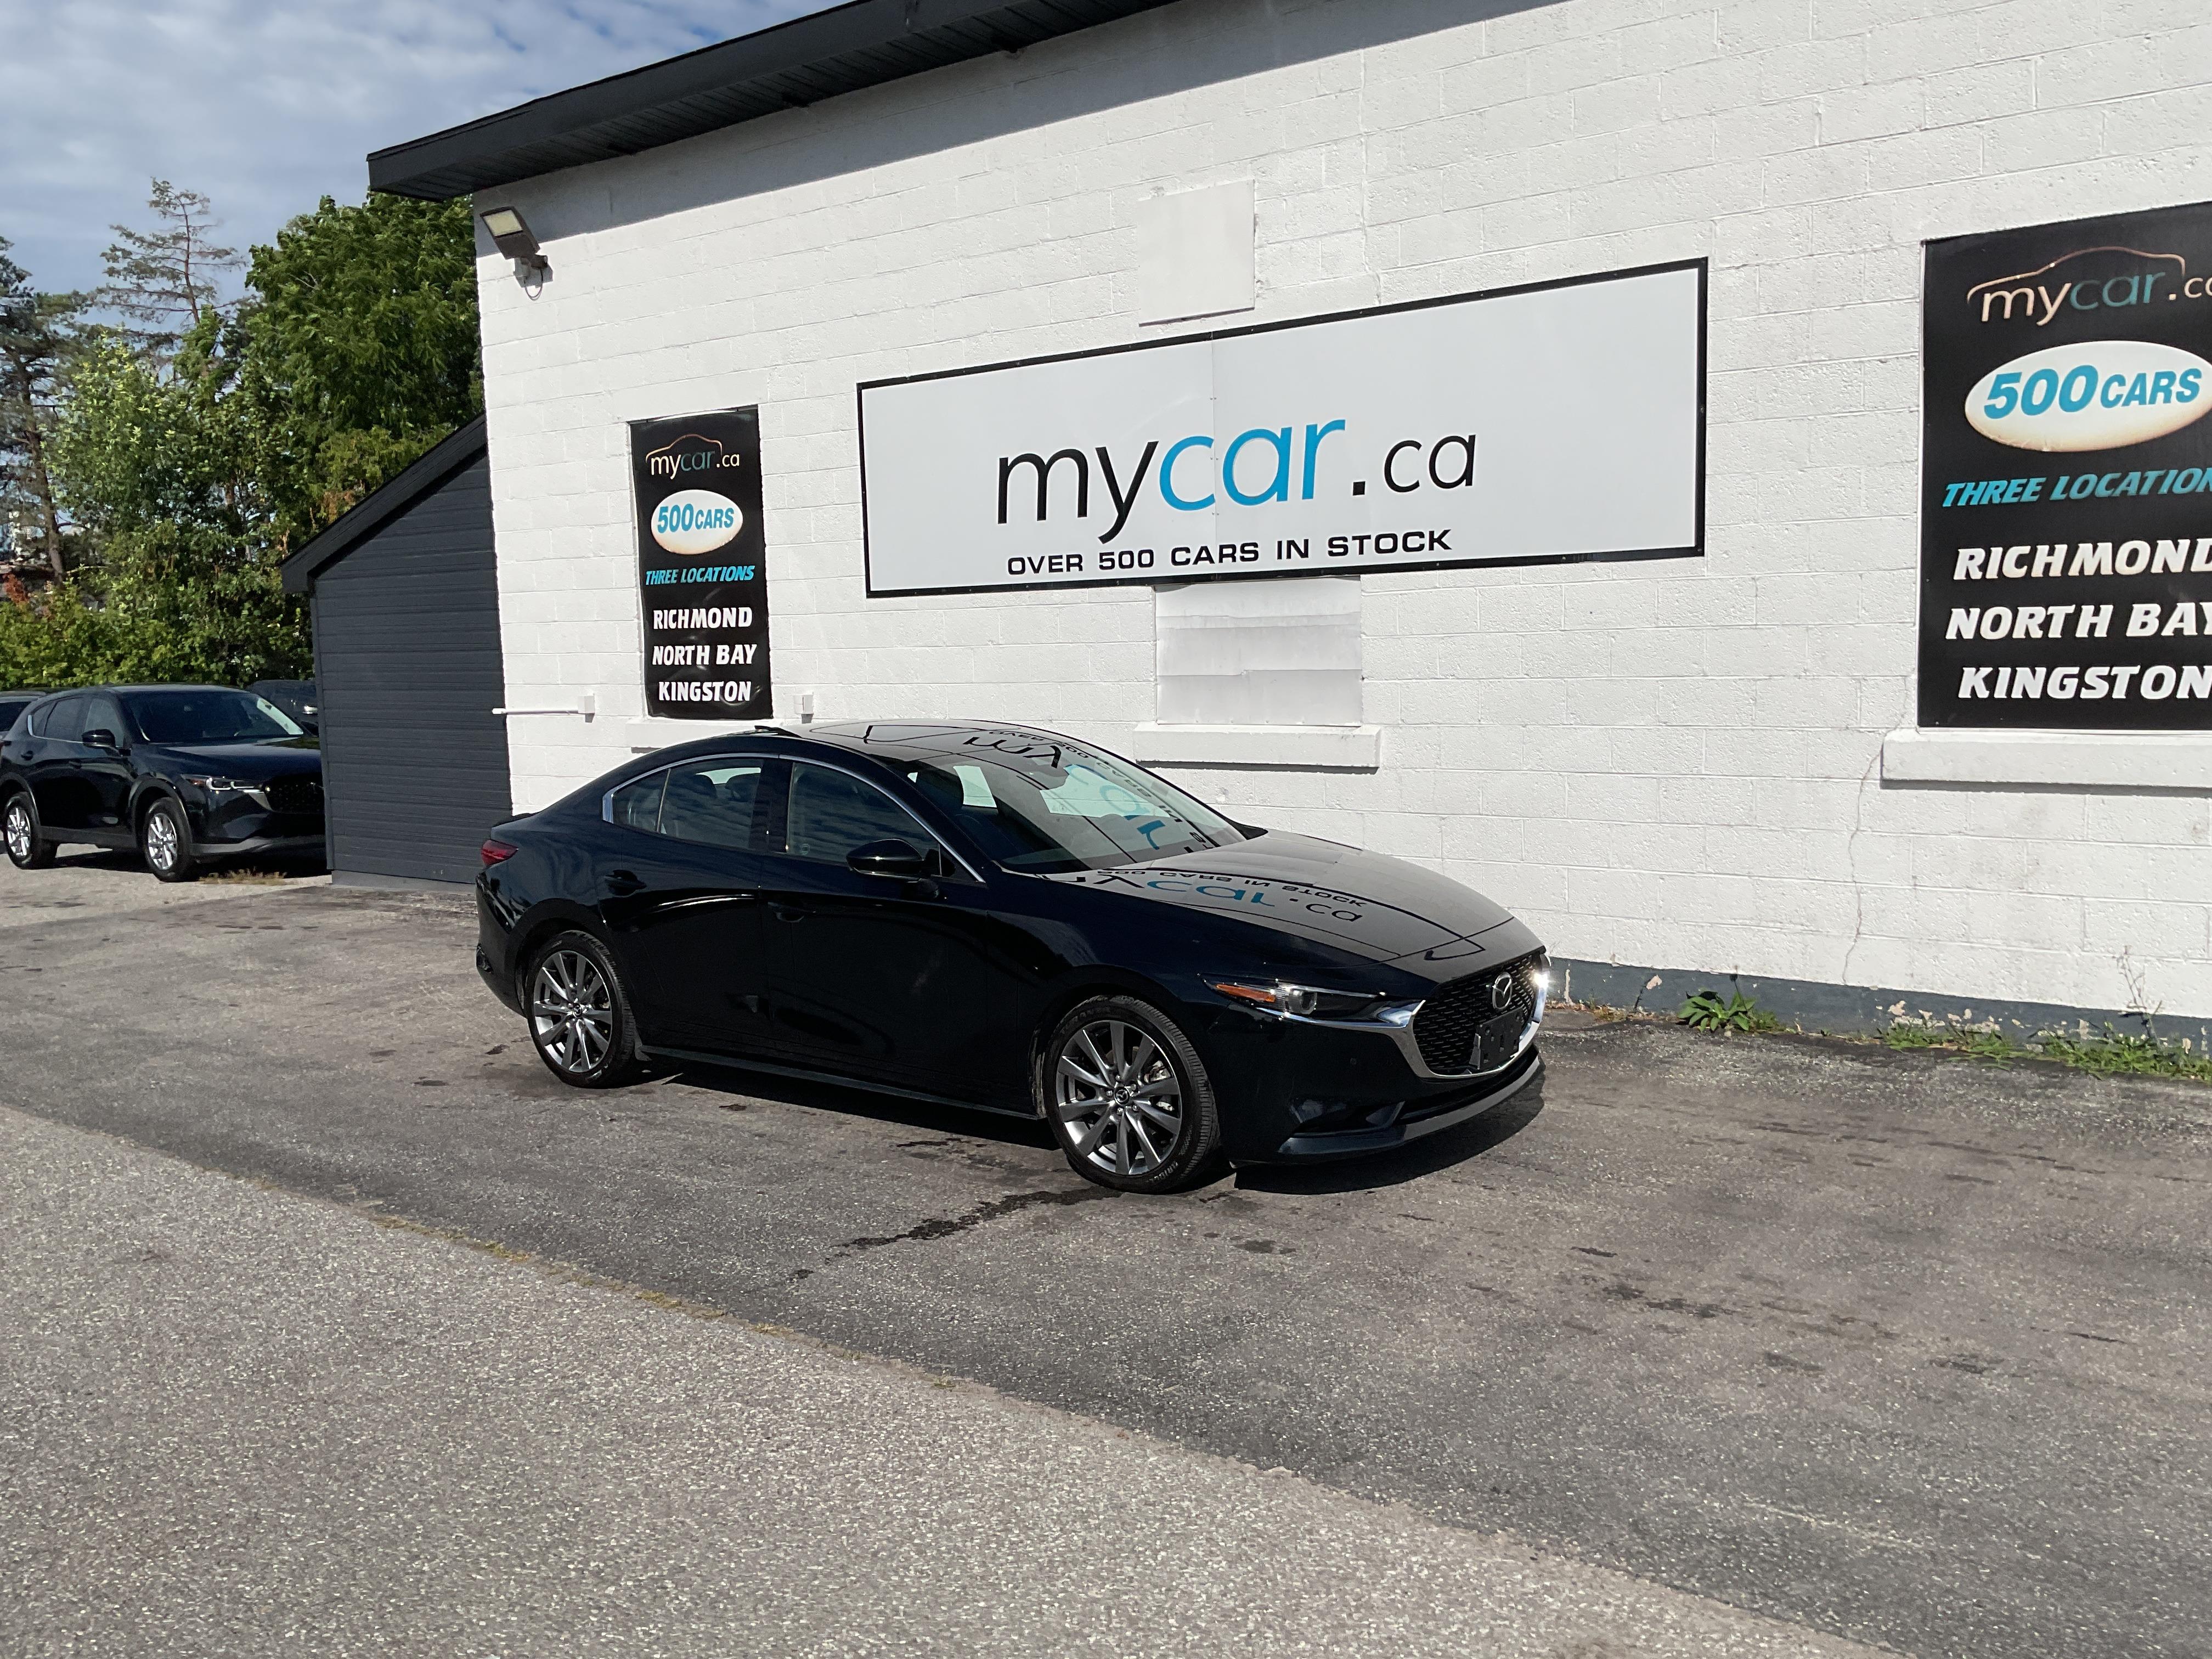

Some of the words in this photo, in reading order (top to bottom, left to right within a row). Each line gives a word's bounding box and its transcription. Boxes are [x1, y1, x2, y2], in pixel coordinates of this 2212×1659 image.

[1983, 365, 2098, 419] 500
[2100, 368, 2203, 408] CARS
[1942, 477, 2046, 507] THREE
[657, 503, 695, 534] 500
[695, 507, 734, 529] CARS
[1008, 554, 1084, 575] OVER
[1098, 549, 1155, 571] 500
[1171, 542, 1260, 567] CARS
[1277, 539, 1310, 560] IN
[1328, 529, 1452, 557] STOCK
[645, 569, 679, 585] THREE
[680, 565, 755, 583] LOCATIONS
[653, 607, 753, 629] RICHMOND
[1945, 604, 2114, 640] NORTH
[652, 644, 710, 665] NORTH
[715, 644, 758, 665] BAY
[658, 681, 752, 702] KINGSTON
[1958, 665, 2212, 700] KINGSTON
